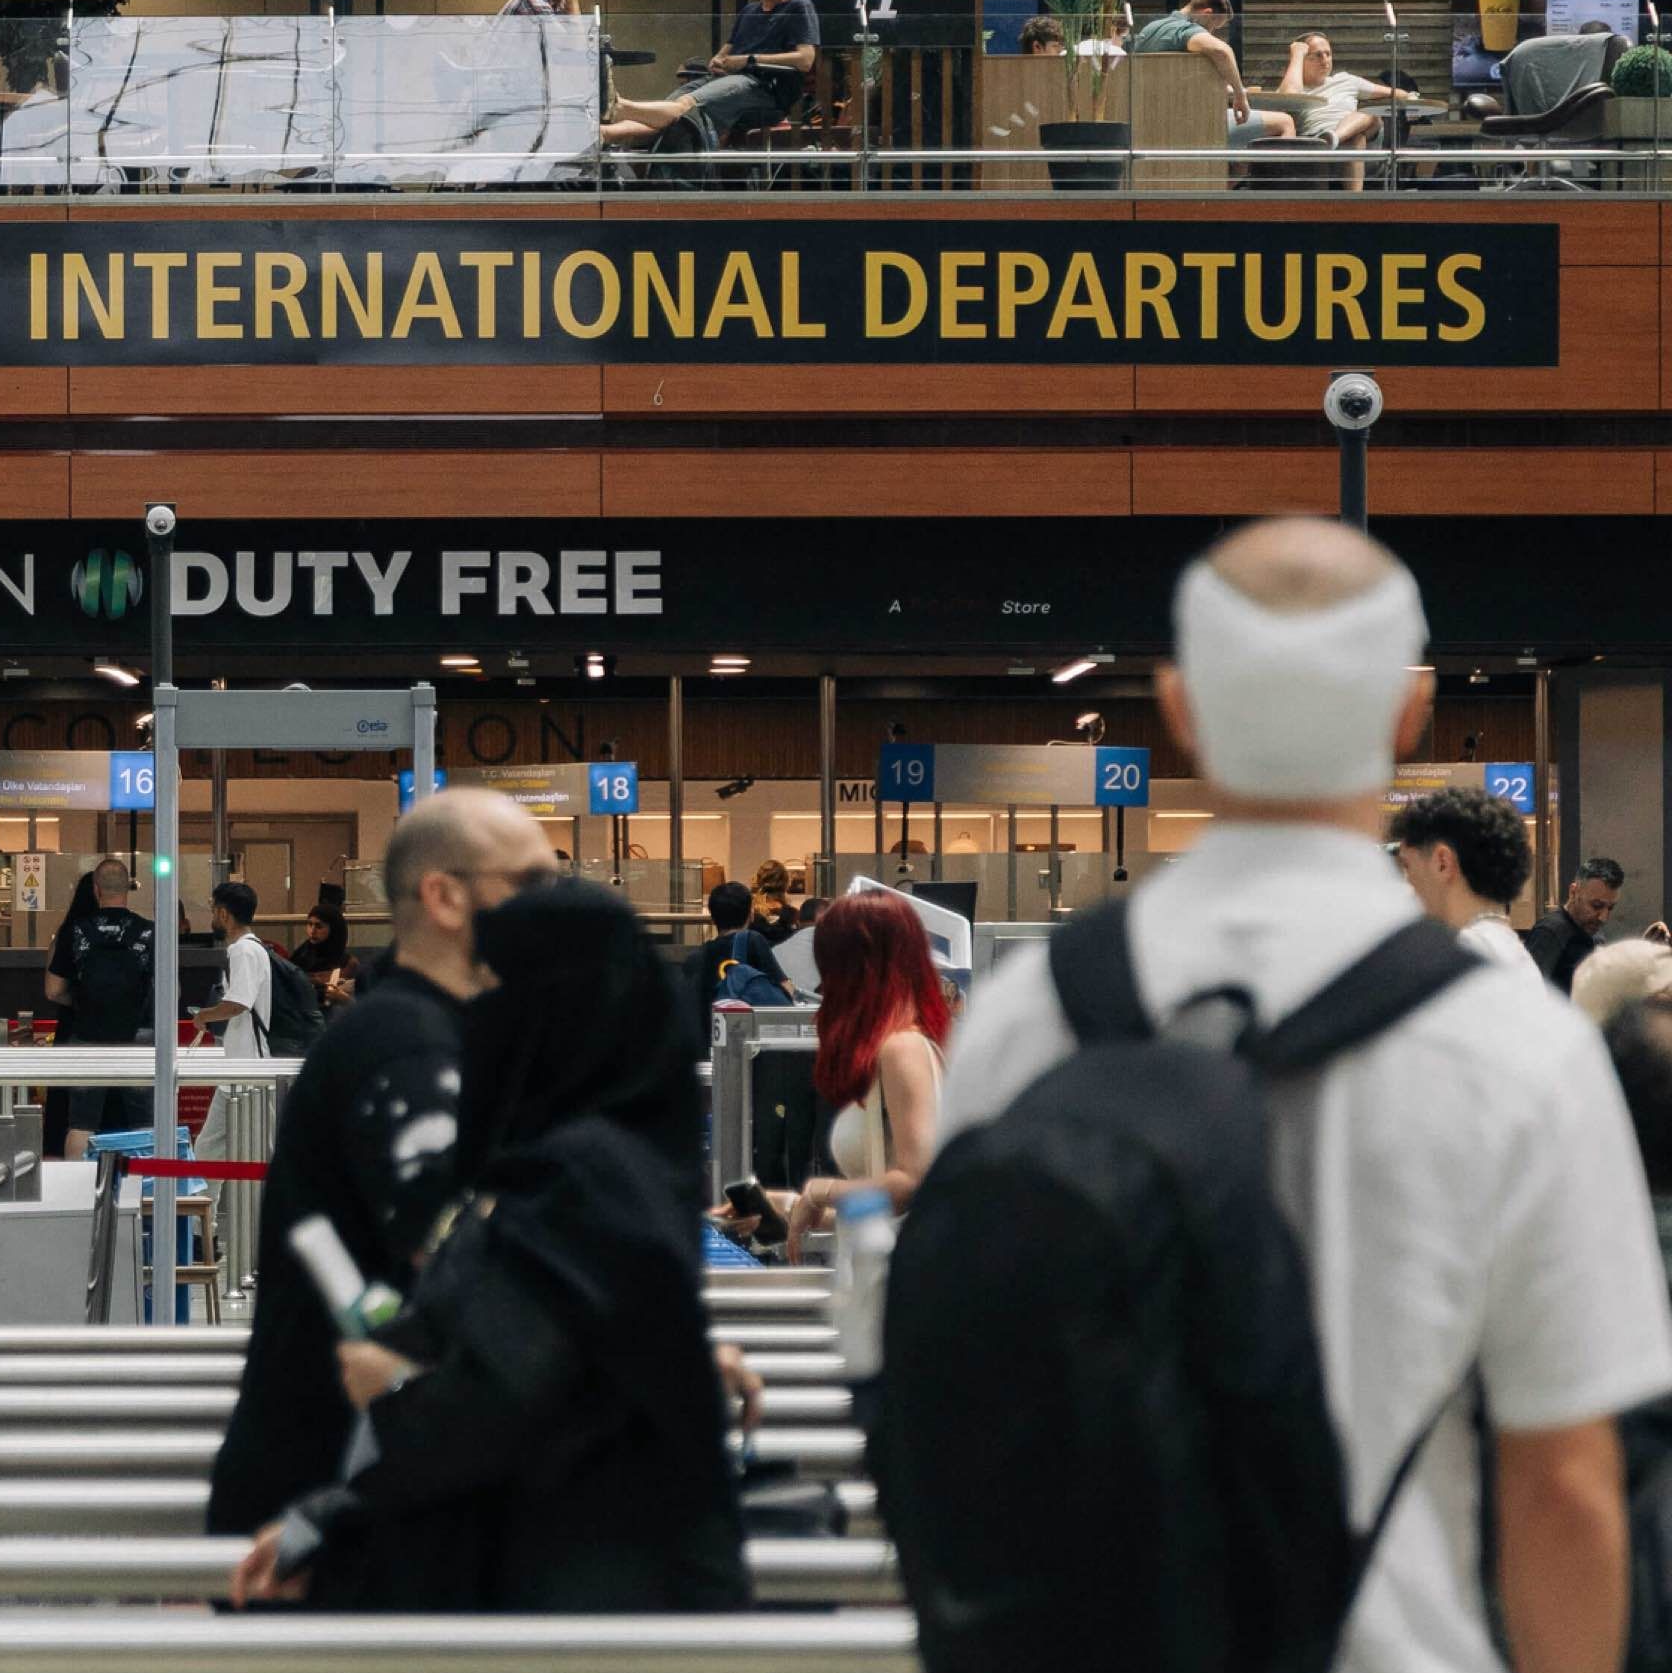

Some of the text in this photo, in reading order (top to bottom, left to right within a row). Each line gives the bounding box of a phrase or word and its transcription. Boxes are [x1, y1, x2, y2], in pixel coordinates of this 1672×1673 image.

[30, 250, 826, 341] INTERNATIONAL
[865, 251, 1485, 342] DEPARTURES
[169, 551, 412, 617] DUTY
[441, 550, 663, 615] FREE
[888, 599, 902, 614] A
[1001, 599, 1052, 615] Store
[119, 767, 153, 794] 16
[890, 759, 925, 786] 19
[1103, 763, 1141, 791] 20
[596, 776, 630, 801] 18
[1493, 776, 1528, 801] 22
[713, 1017, 721, 1042] 6
